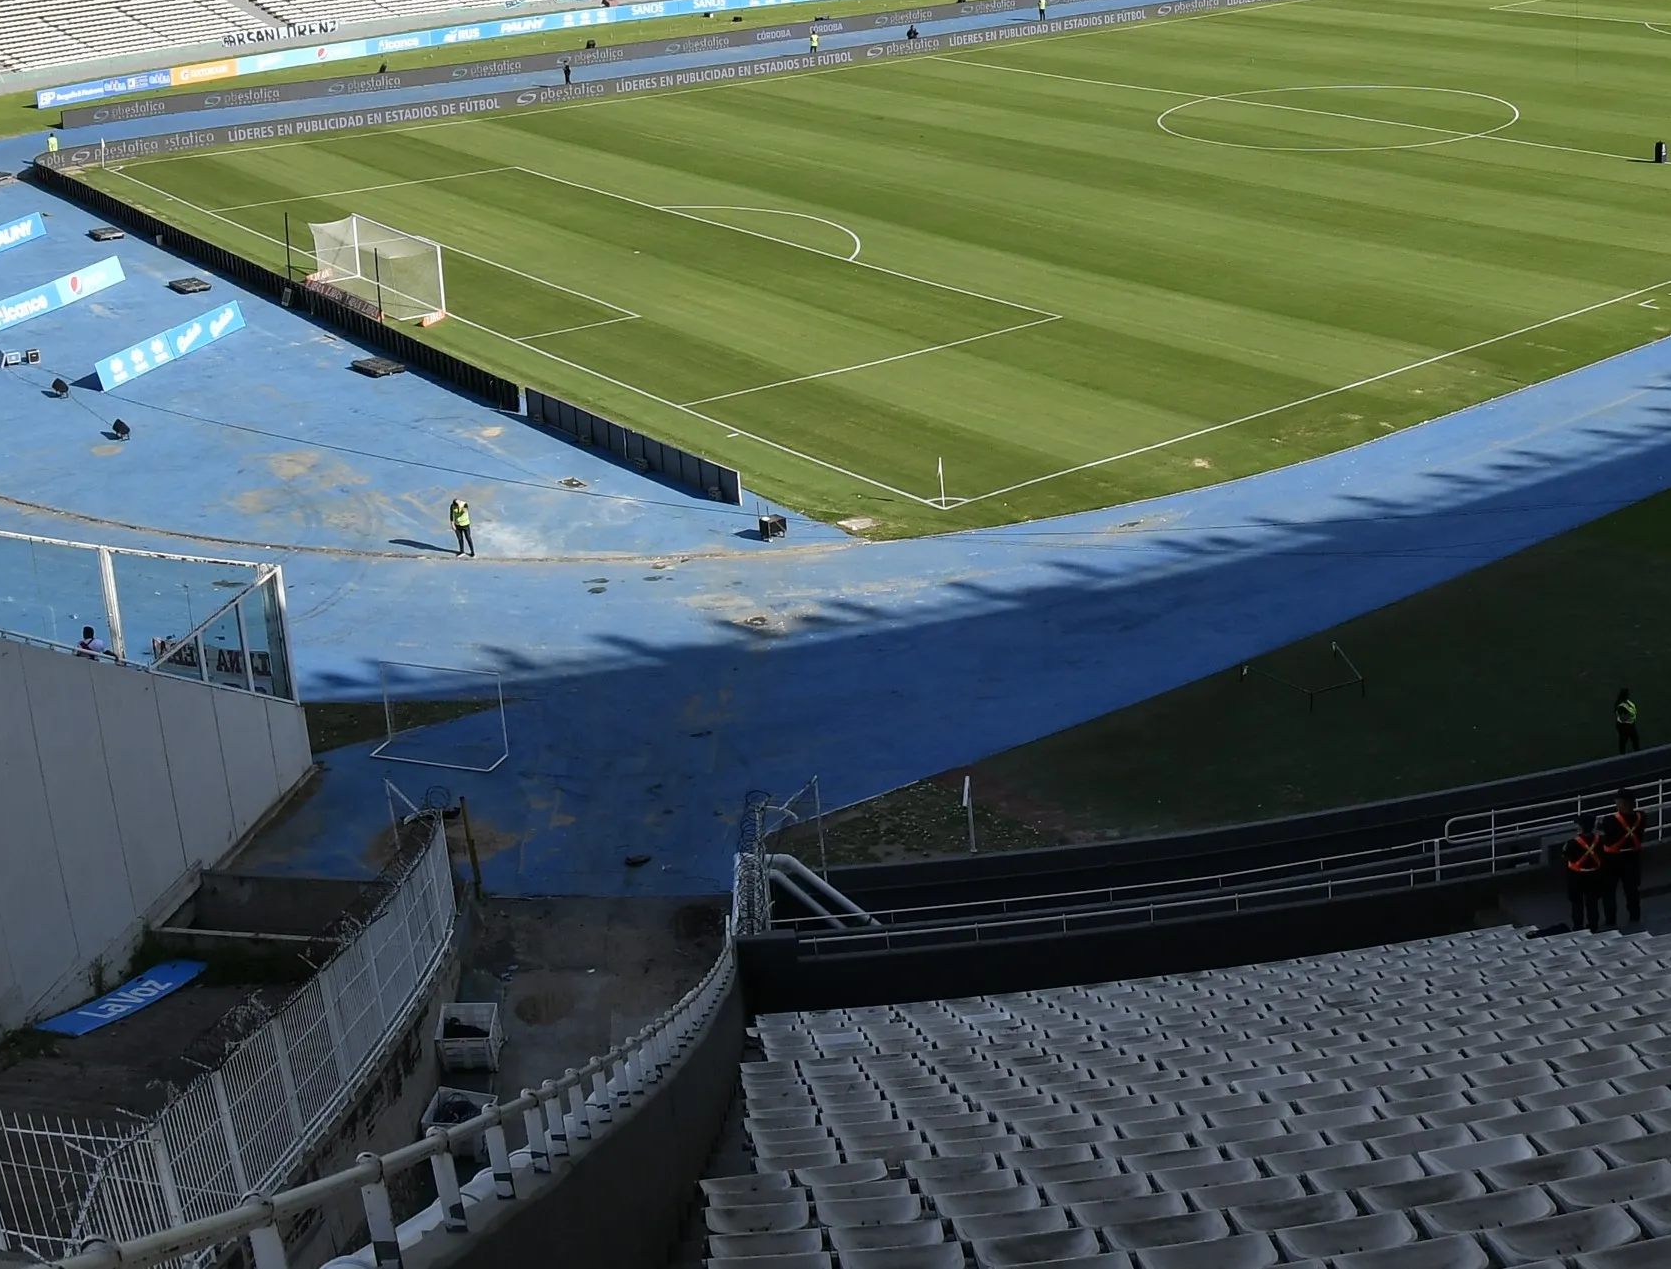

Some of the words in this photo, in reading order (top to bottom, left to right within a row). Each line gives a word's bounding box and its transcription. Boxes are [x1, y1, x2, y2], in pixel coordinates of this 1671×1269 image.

[631, 3, 664, 16] SANOS
[756, 27, 792, 41] CÓRDOBA
[810, 21, 843, 35] CÓRDOBA
[949, 32, 984, 47] LÍDERES
[985, 30, 998, 43] EN
[999, 24, 1048, 41] PUBLICIDAD
[1050, 22, 1062, 34] EN
[1064, 16, 1101, 31] ESTADIOS
[1103, 15, 1115, 26] DE
[1117, 9, 1147, 23] FÚTBOL
[616, 78, 658, 97] LÍDERES
[661, 74, 674, 89] EN
[676, 67, 735, 86] PUBLICIDAD
[738, 65, 751, 78] EN
[754, 59, 796, 75] ESTADIOS
[799, 57, 815, 70] DE
[817, 50, 853, 67] FÚTBOL
[228, 121, 274, 143] LÍDERES
[277, 123, 292, 138] EN
[296, 115, 364, 136] PUBLICIDAD
[368, 113, 383, 127] EN
[386, 106, 438, 124] ESTADIOS
[441, 103, 456, 116] DE
[459, 95, 501, 113] FÚTBOL
